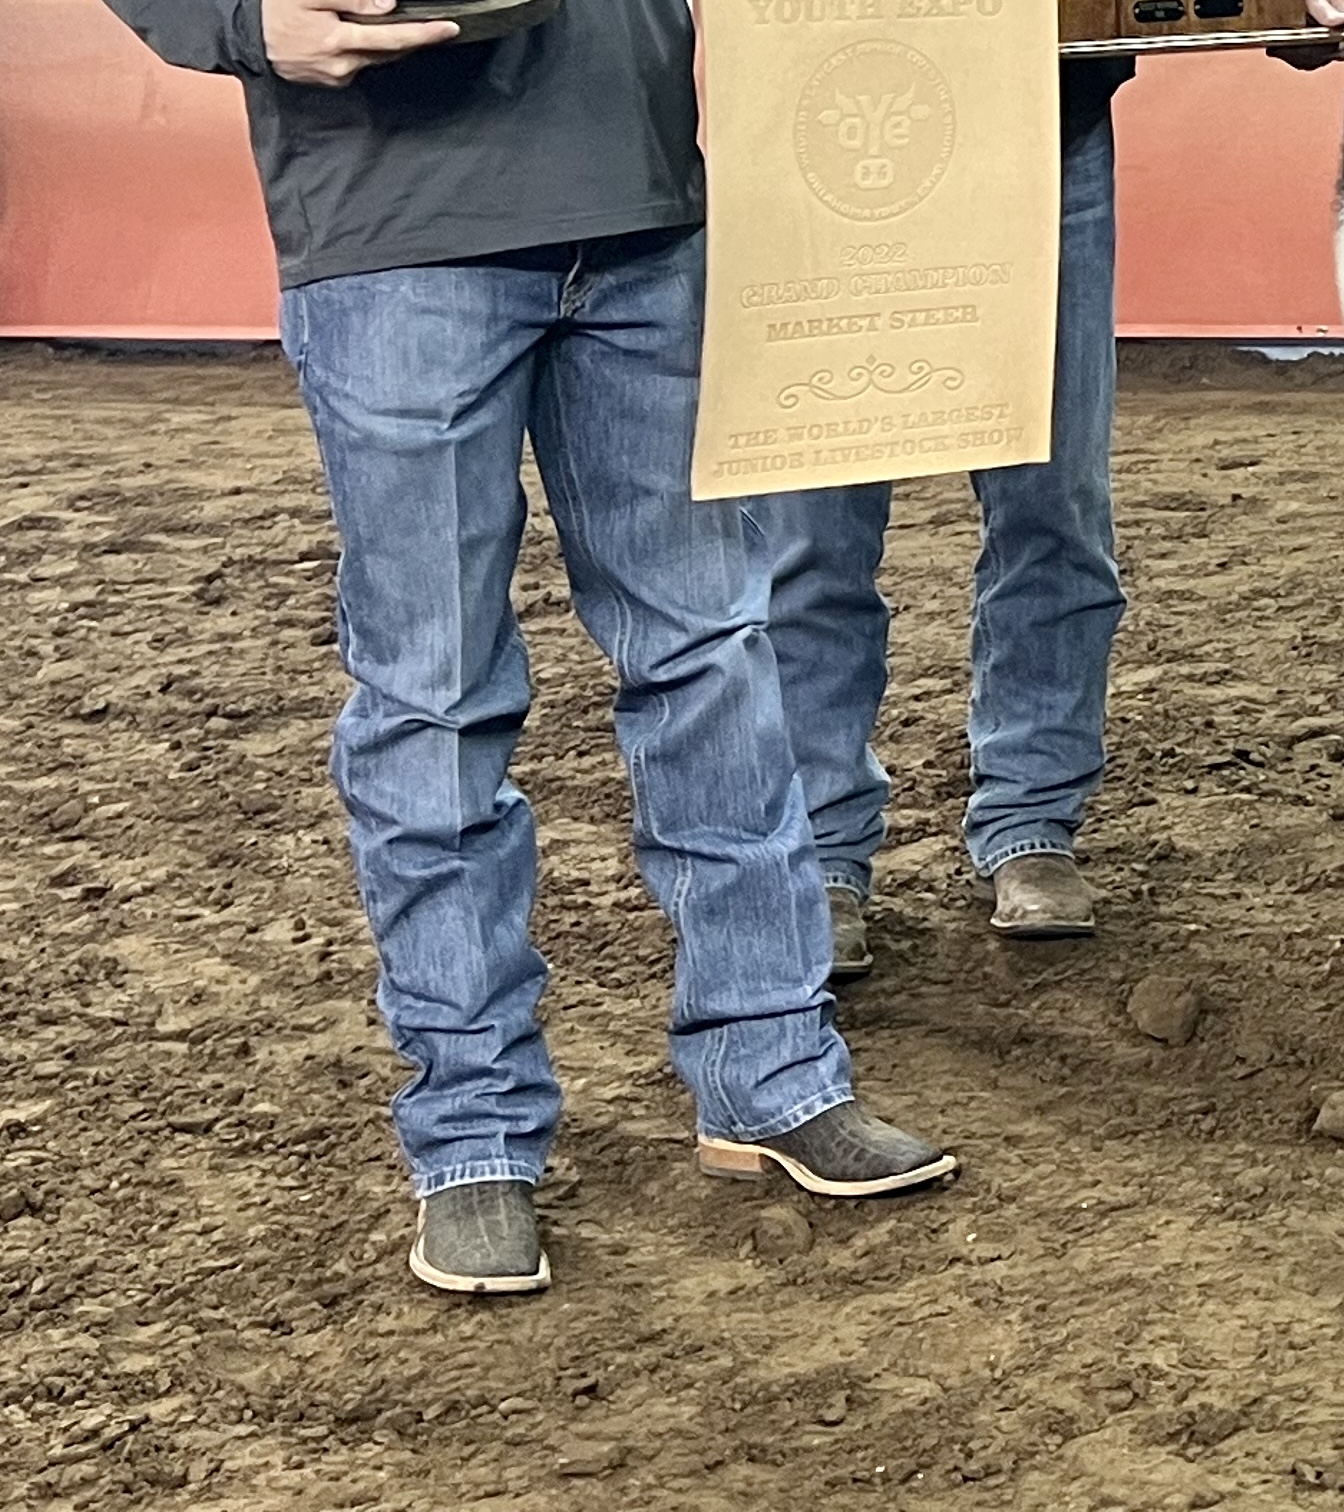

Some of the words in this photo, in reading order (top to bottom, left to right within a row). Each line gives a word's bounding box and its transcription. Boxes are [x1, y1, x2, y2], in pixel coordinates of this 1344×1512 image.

[840, 242, 908, 267] 2022
[739, 277, 842, 309] GRAND
[848, 262, 1012, 297] CHAMPION
[766, 313, 881, 342] MARKET
[889, 305, 979, 330] STEER
[728, 429, 778, 450] THE
[785, 414, 896, 444] WORLD'S
[901, 402, 1011, 430] LARGEST
[713, 451, 805, 479] JUNIOR
[811, 435, 951, 466] LIVESTOCK
[957, 426, 1025, 450] SHOW
